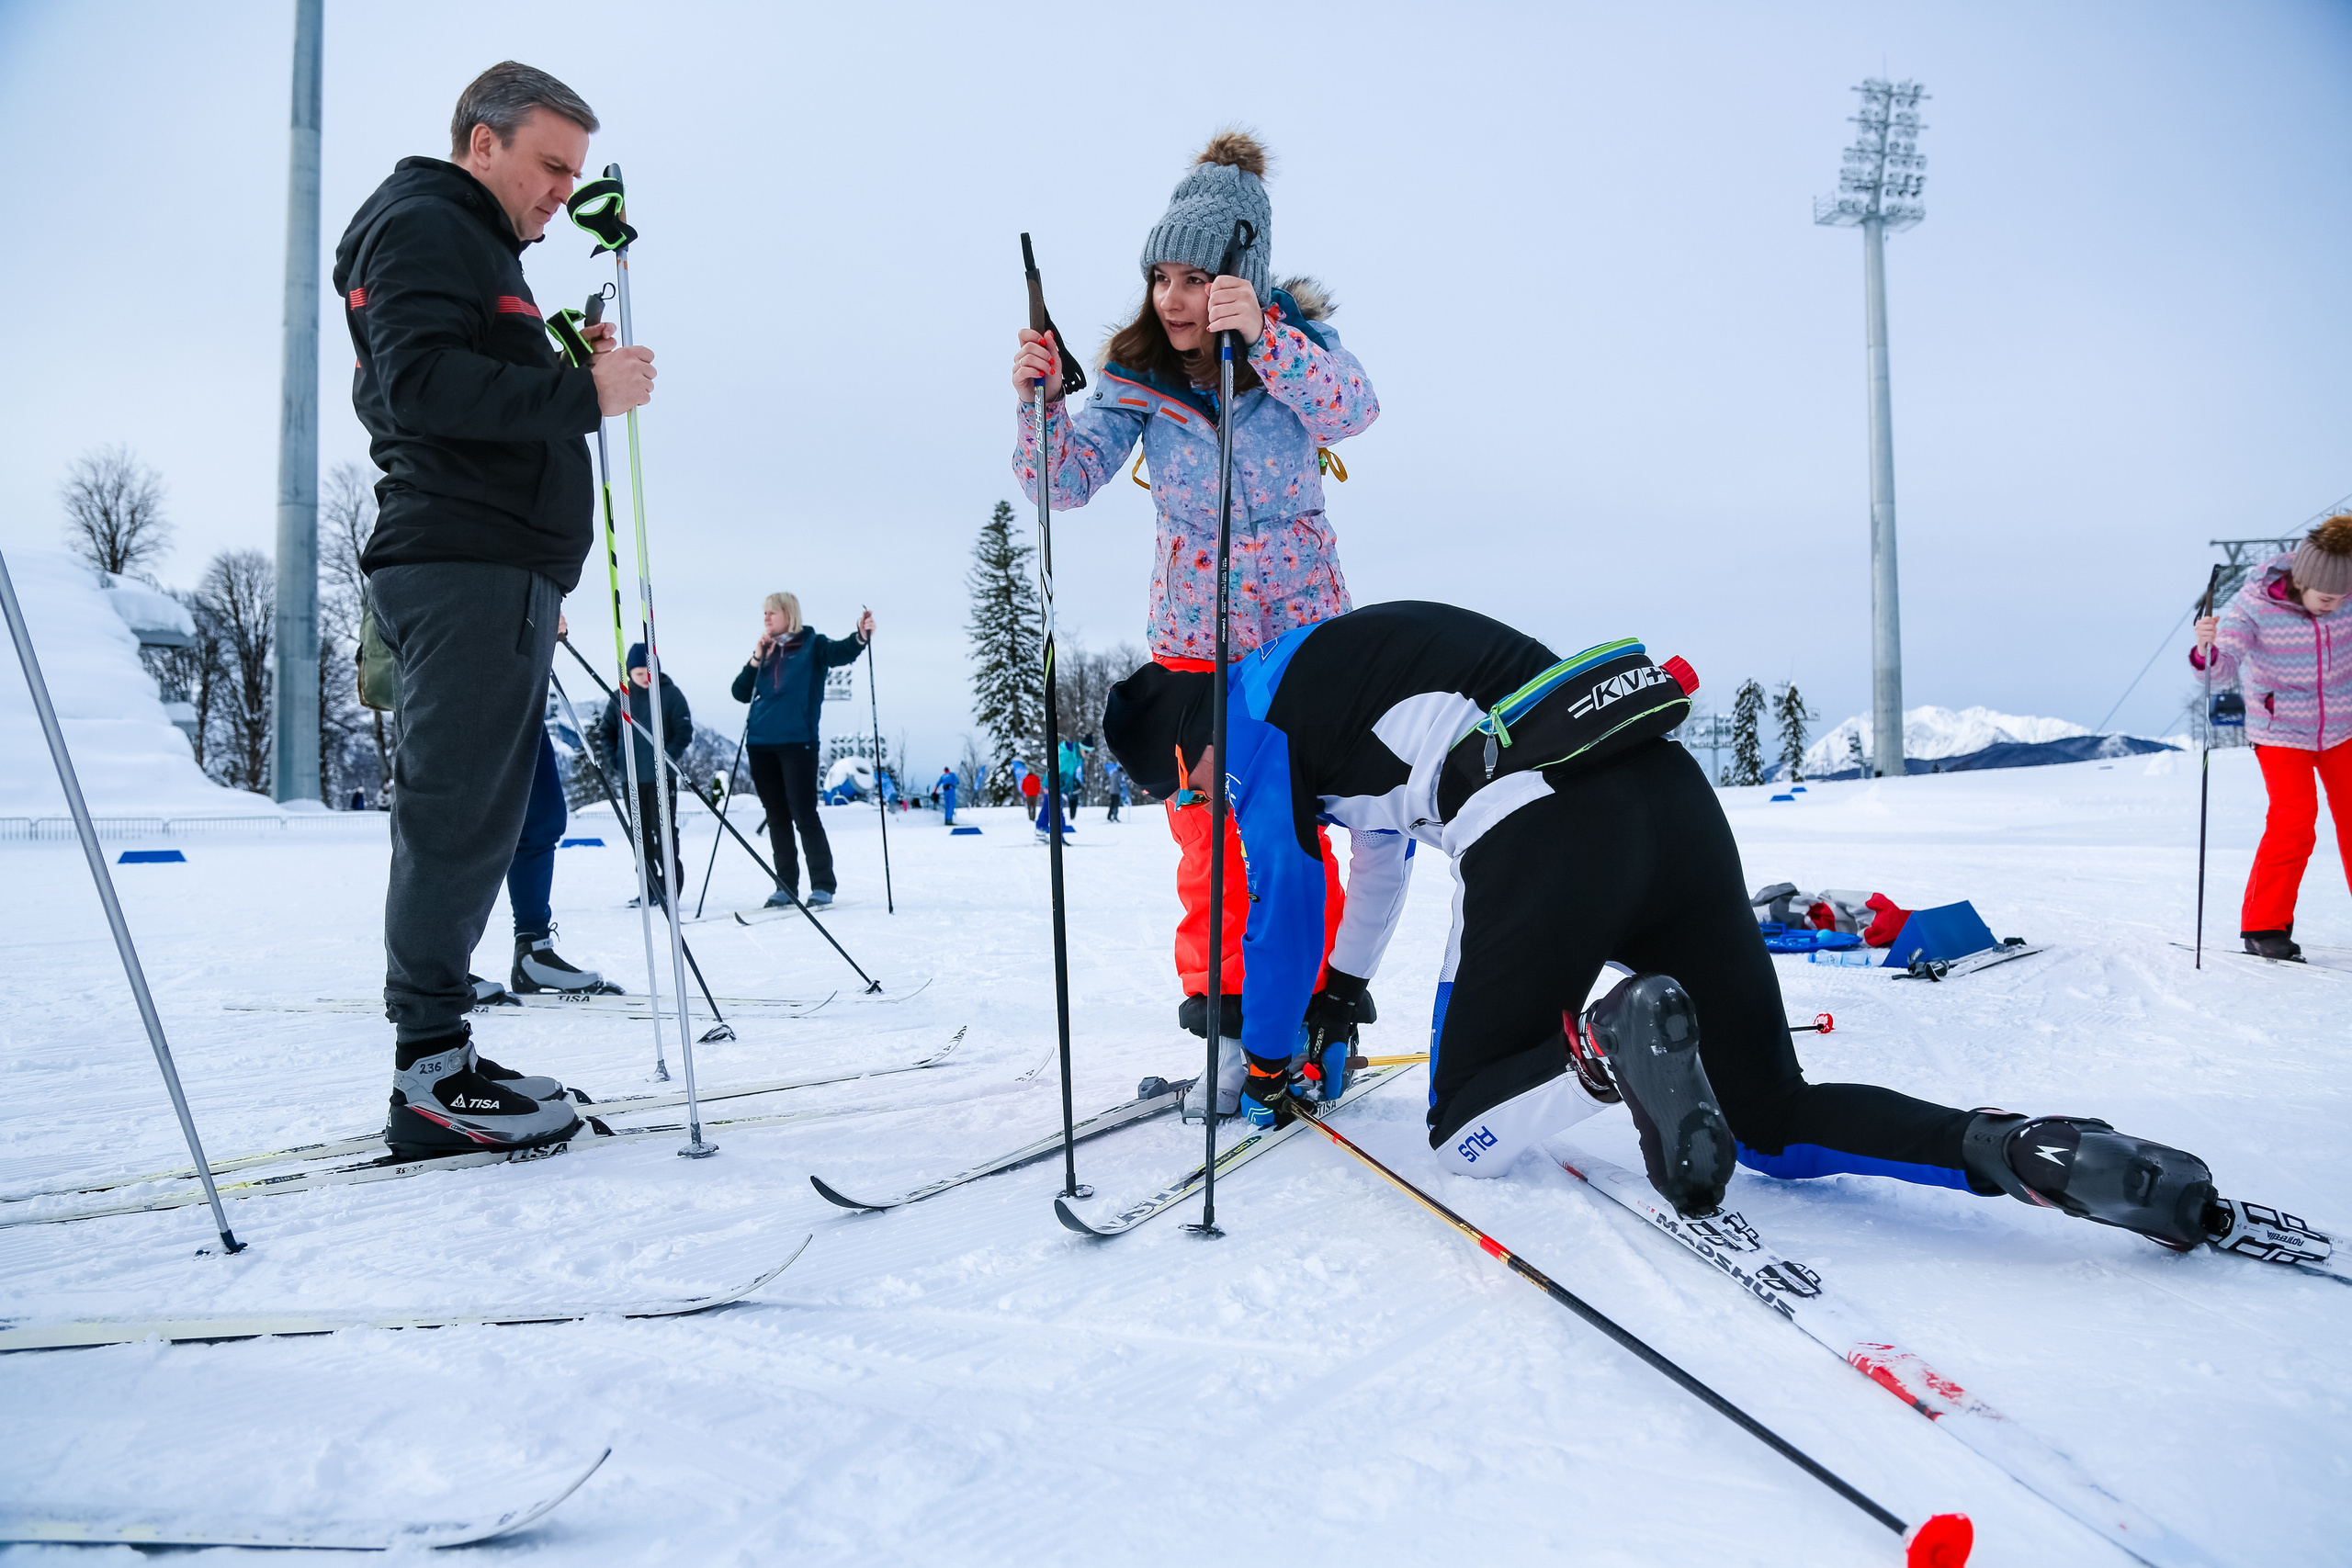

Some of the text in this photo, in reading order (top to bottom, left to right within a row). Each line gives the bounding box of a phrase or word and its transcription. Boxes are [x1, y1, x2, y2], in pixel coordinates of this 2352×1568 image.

[1034, 393, 1045, 455] FISCHER
[419, 1061, 442, 1075] 236
[1174, 1086, 1193, 1100] TIS
[469, 1099, 500, 1110] TISA
[1317, 1100, 1337, 1116] TISA
[1457, 1125, 1498, 1163] RUS
[1656, 1213, 1796, 1322] MADSHUS
